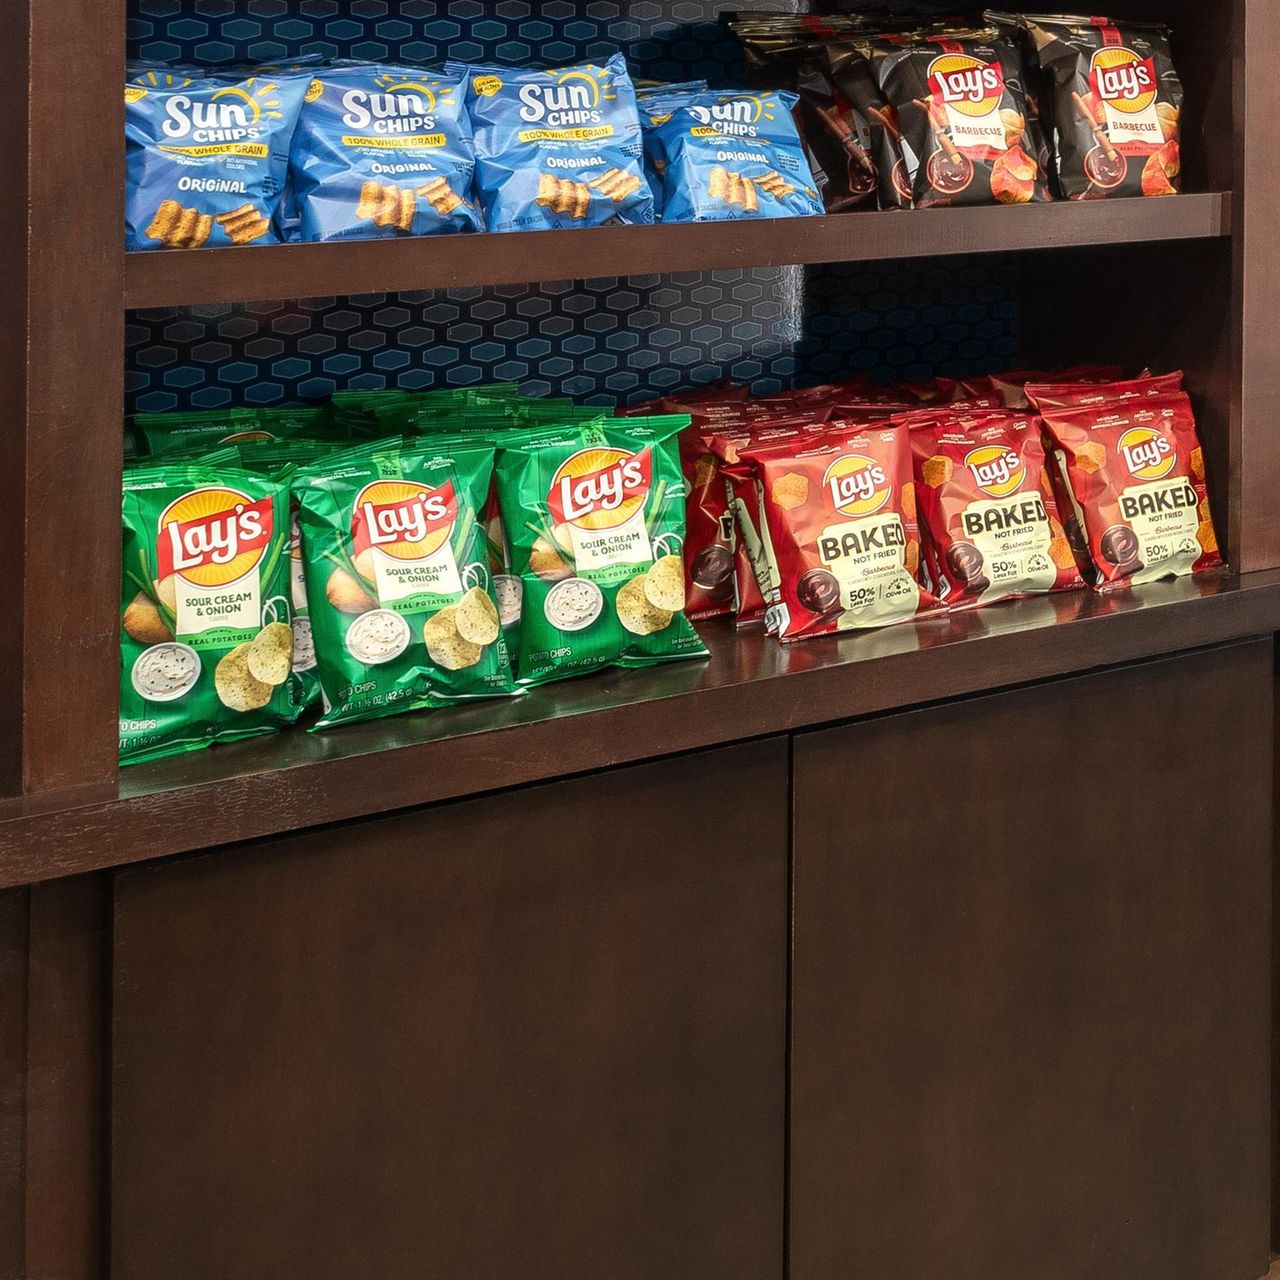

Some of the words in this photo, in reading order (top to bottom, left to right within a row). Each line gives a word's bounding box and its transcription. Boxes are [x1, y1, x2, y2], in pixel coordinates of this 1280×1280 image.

[935, 66, 998, 102] Lay's
[1096, 61, 1150, 100] Lay's
[343, 90, 425, 129] Sun
[519, 84, 592, 122] Sun
[163, 95, 249, 137] Sun
[547, 111, 600, 125] CHIPS
[373, 116, 435, 133] CHIPS
[712, 121, 757, 137] CHIPS
[955, 125, 1002, 136] BARBECUE
[1112, 121, 1156, 132] BARBECUE
[193, 127, 261, 142] CHIPS
[375, 137, 410, 147] WHOLE
[412, 136, 441, 147] GRAIN
[1122, 435, 1172, 474] Lay's
[967, 451, 1020, 487] Lay's
[560, 458, 643, 521] Lay's
[829, 464, 886, 509] Lay's
[1121, 488, 1198, 519] BAKED
[363, 493, 448, 544] Lay's
[964, 500, 1048, 536] BAKED
[1148, 515, 1163, 523] NOT
[1164, 511, 1184, 520] FRIED
[167, 505, 263, 570] Lay's
[994, 530, 1012, 540] NOT
[1013, 526, 1034, 536] FRIED
[581, 539, 607, 550] SOUR
[608, 533, 640, 545] CREAM
[601, 543, 633, 555] ONION
[821, 522, 905, 562] BAKED
[853, 555, 872, 565] NOT
[873, 549, 897, 560] FRIED
[1146, 544, 1168, 557] 50%
[386, 567, 413, 576] SOUR
[414, 564, 448, 575] CREAM
[992, 561, 1017, 573] 50%
[407, 574, 439, 583] ONION
[186, 596, 212, 607] SOUR
[214, 592, 252, 605] CREAM
[849, 587, 875, 602] 50%
[204, 603, 241, 614] ONION
